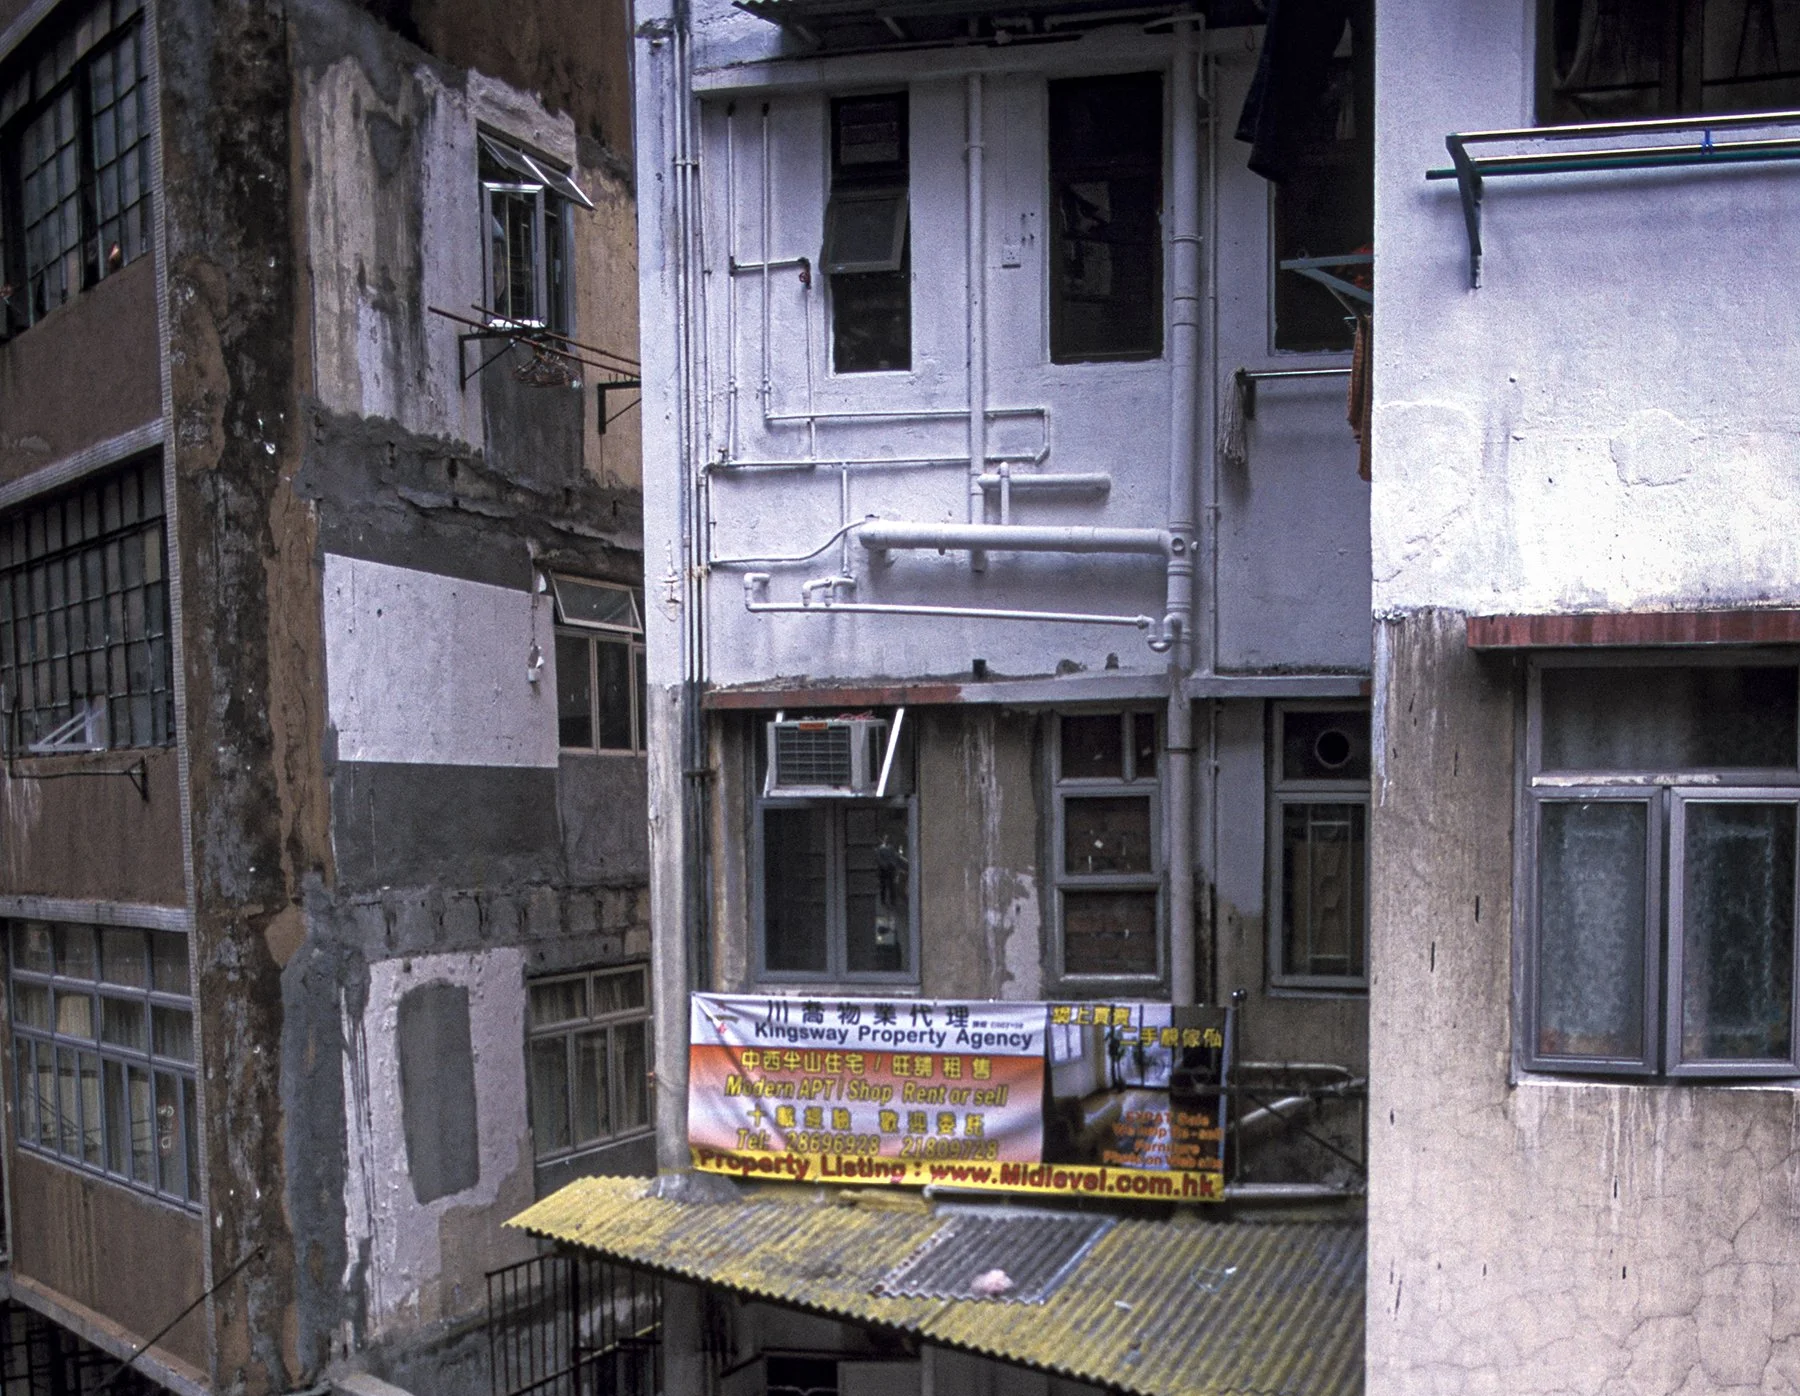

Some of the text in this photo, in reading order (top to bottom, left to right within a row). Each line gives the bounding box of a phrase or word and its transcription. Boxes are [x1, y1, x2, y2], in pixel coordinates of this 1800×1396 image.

[754, 1021, 1034, 1050] Kingsway Property Agency
[741, 1050, 865, 1075] 中西半山住宅
[725, 1073, 795, 1098] Modern
[797, 1076, 835, 1101] APT
[848, 1079, 893, 1107] Shop
[902, 1080, 947, 1105] Rent
[950, 1084, 970, 1106] or
[973, 1083, 1009, 1108] sell
[736, 1127, 771, 1150] Tel:
[784, 1130, 881, 1157] 28696928
[699, 1150, 811, 1181] Property
[820, 1153, 907, 1184] Listing
[929, 1161, 1215, 1198] www.Midlevel.com.hk
